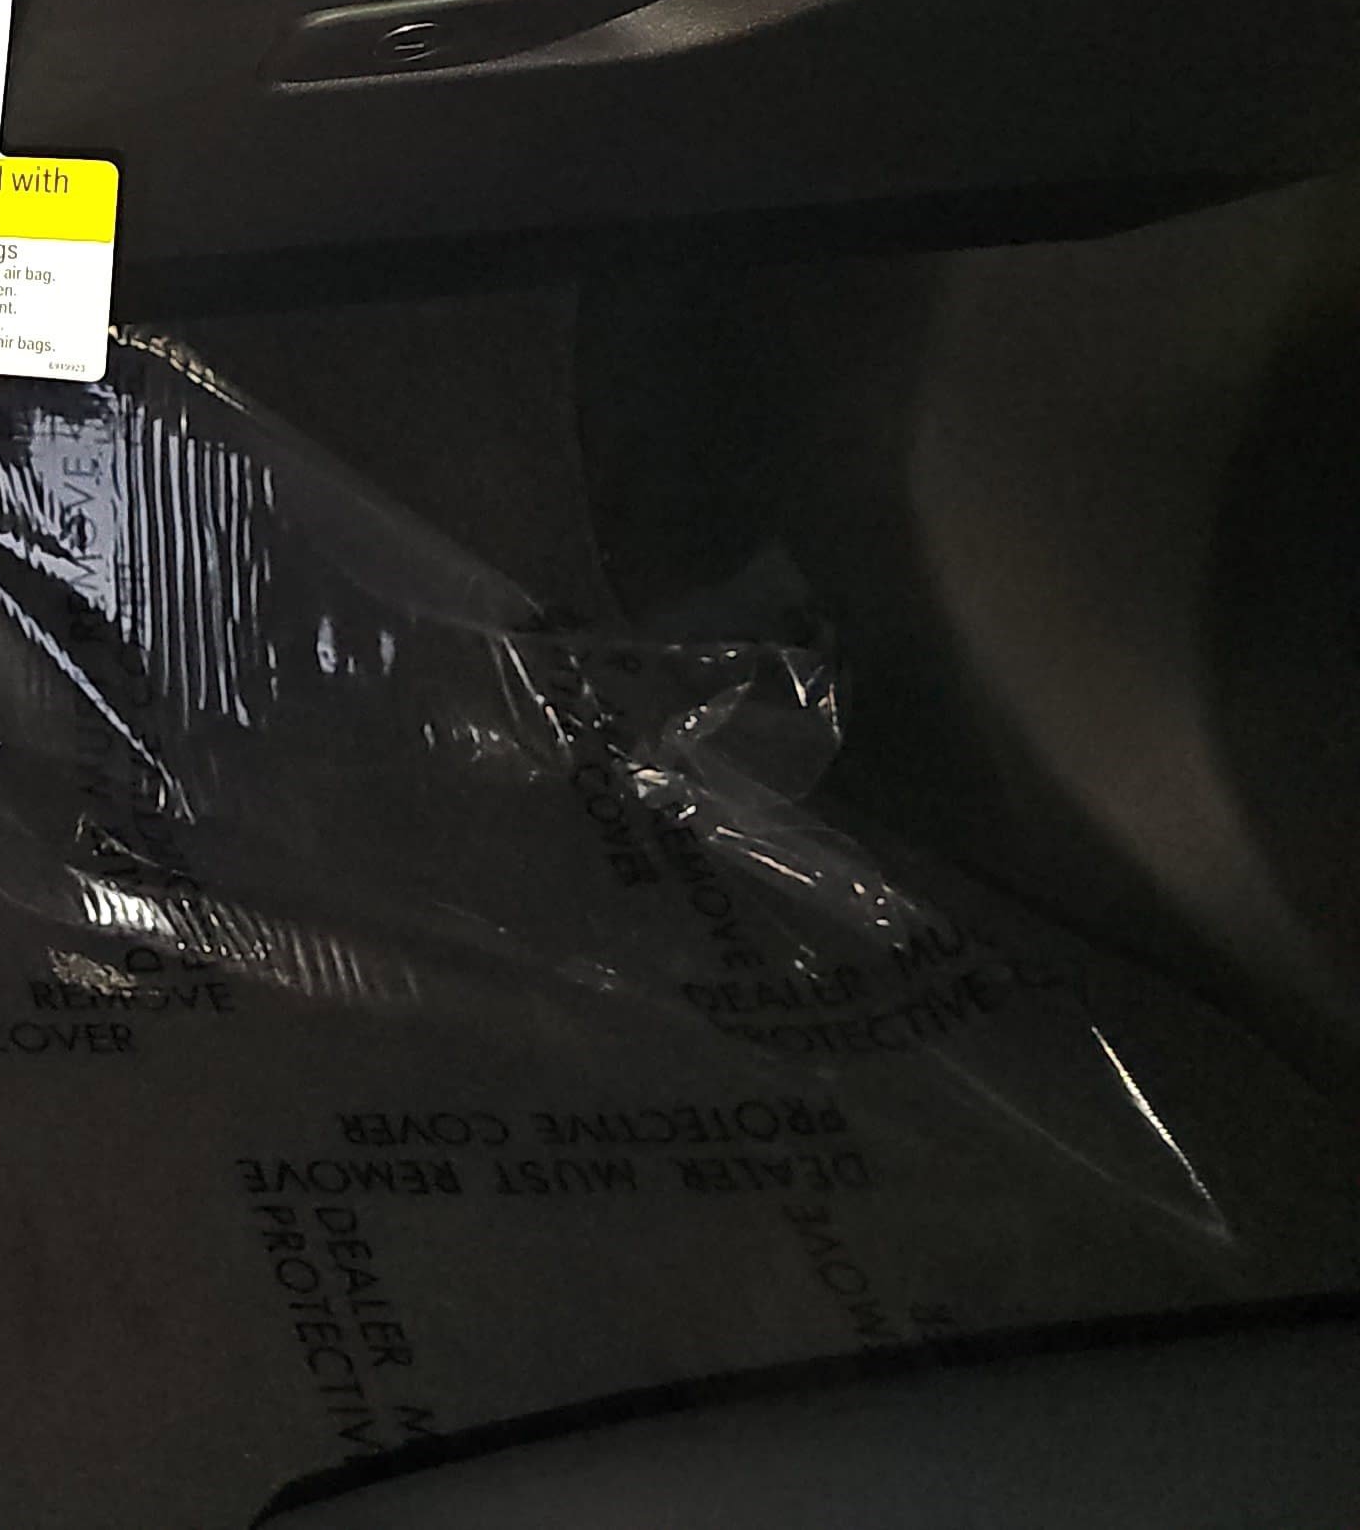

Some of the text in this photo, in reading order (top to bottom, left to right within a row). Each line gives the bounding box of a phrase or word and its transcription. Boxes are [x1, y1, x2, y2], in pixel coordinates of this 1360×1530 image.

[12, 166, 69, 194] with
[3, 266, 22, 280] air
[25, 267, 56, 284] bag.
[17, 336, 56, 354] bags.
[235, 1157, 464, 1197] REMOVE
[314, 1206, 416, 1368] DEALER
[252, 1205, 385, 1454] PROTECTIV
